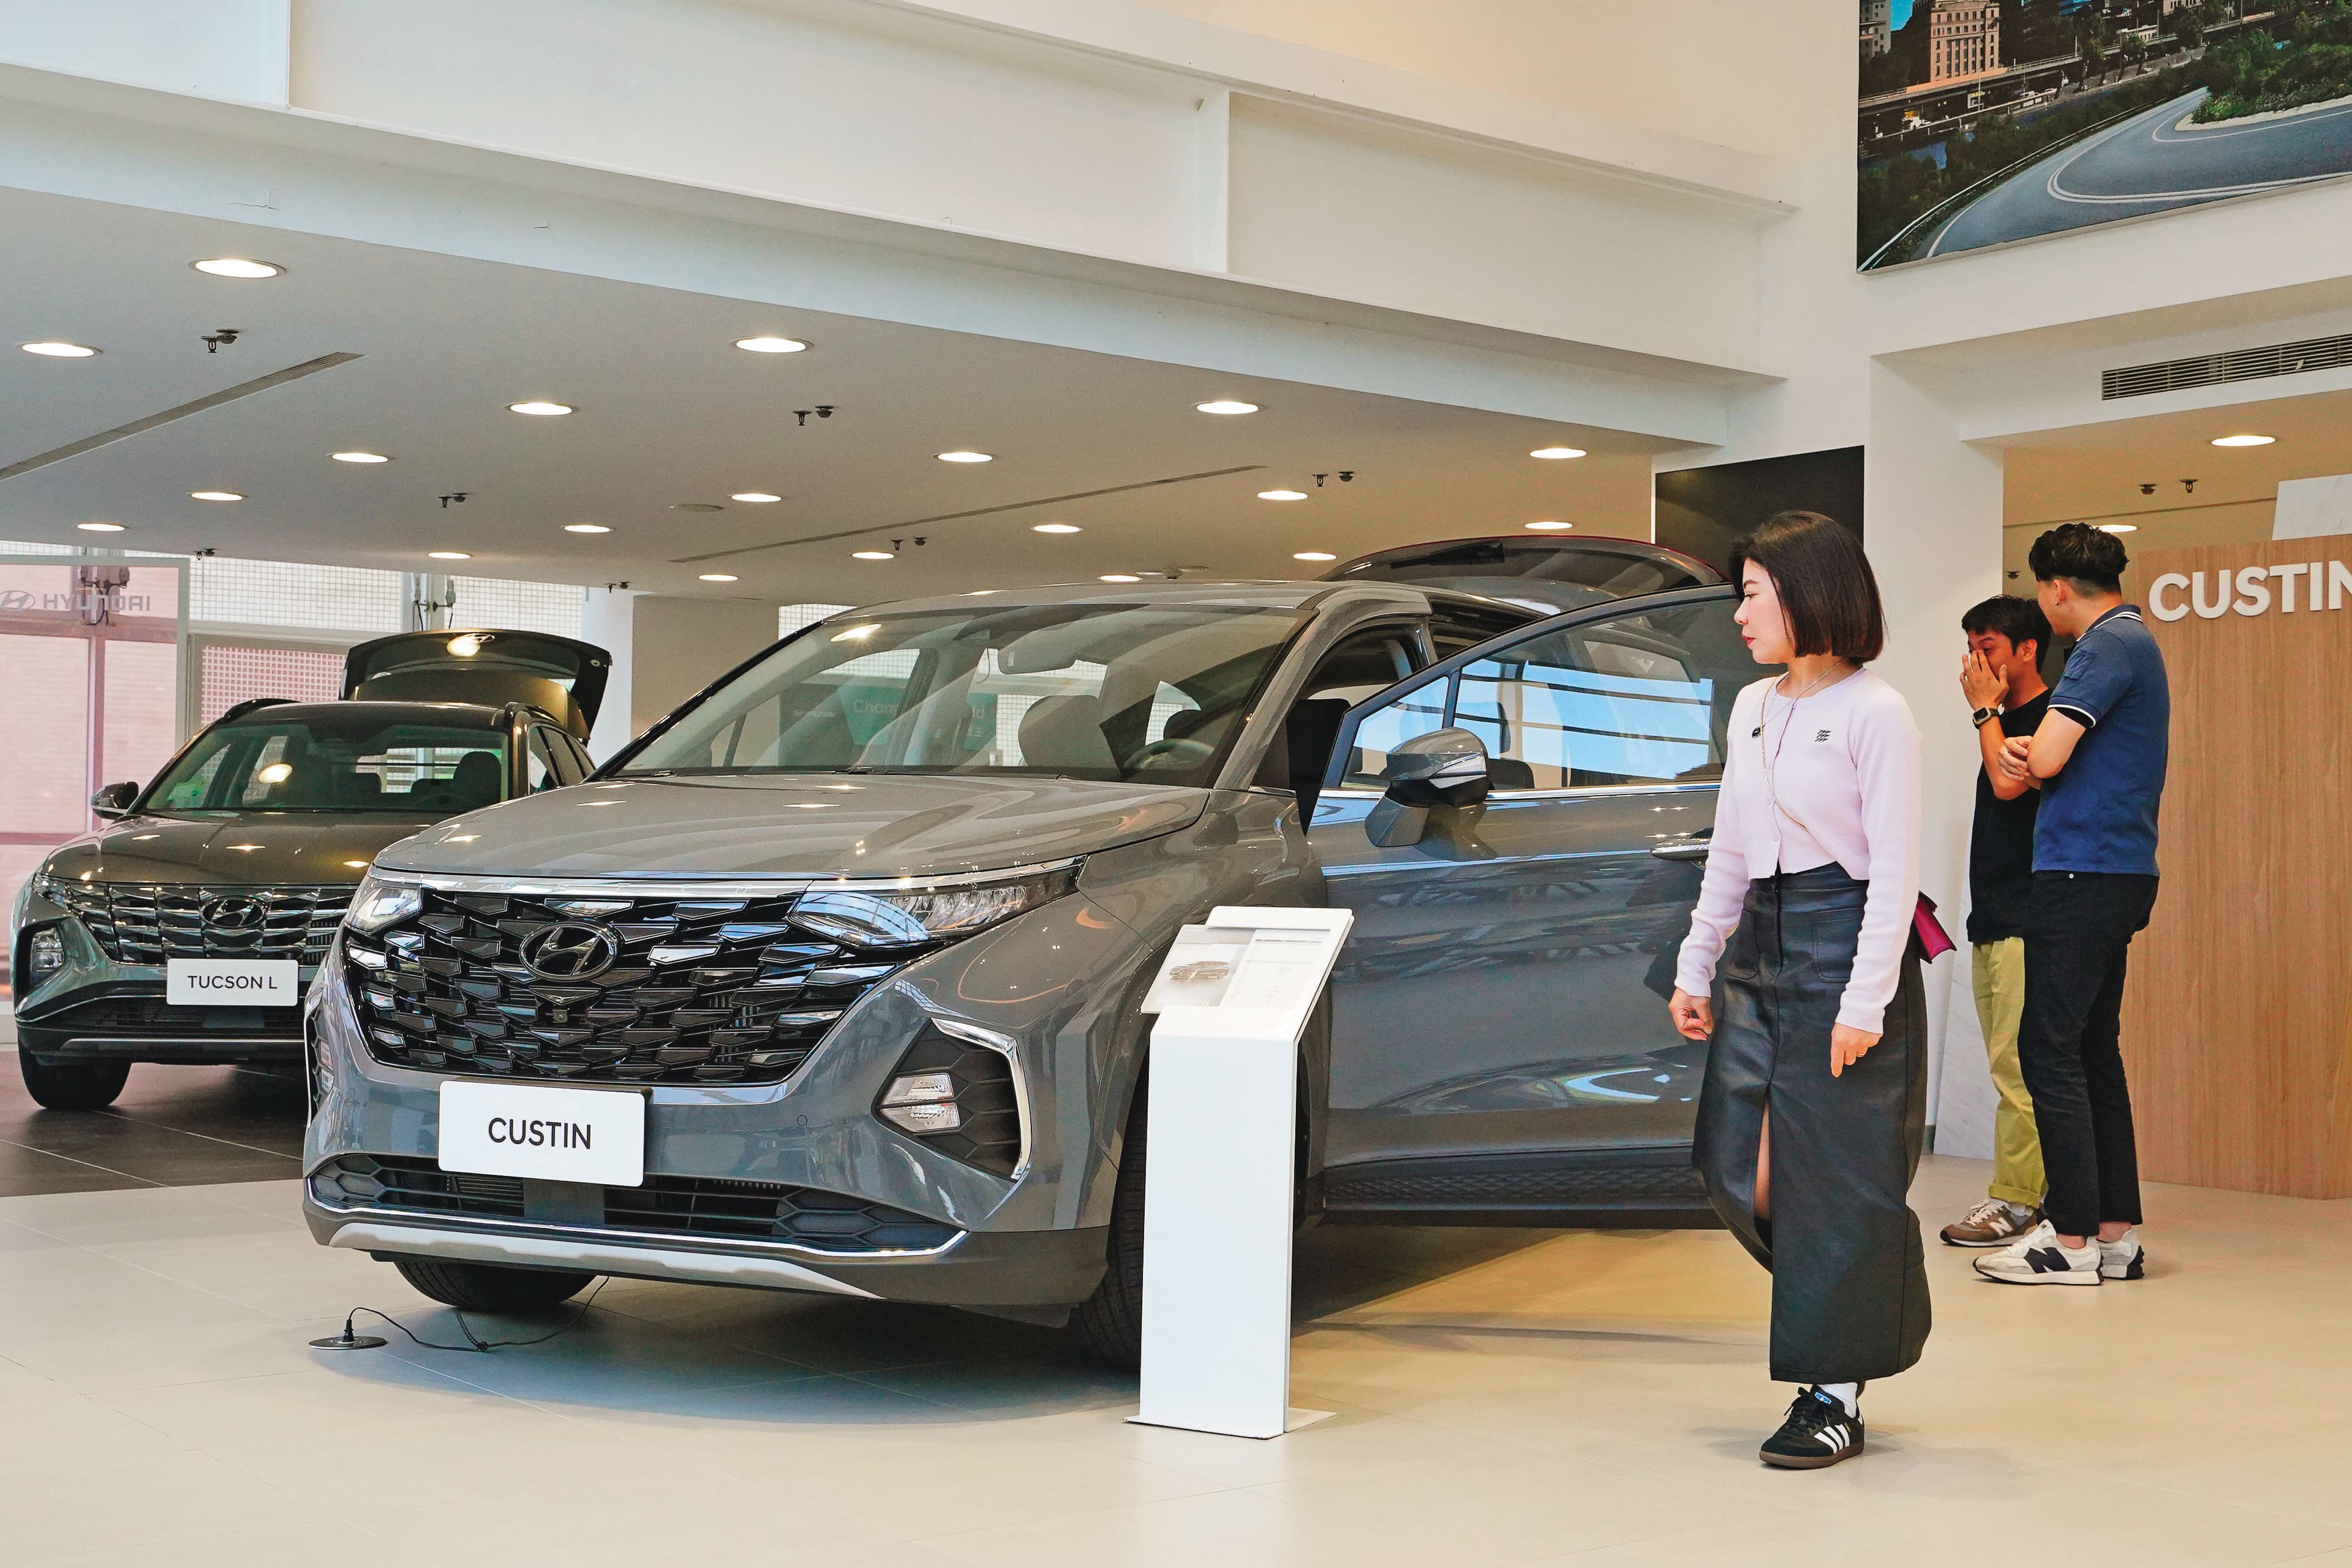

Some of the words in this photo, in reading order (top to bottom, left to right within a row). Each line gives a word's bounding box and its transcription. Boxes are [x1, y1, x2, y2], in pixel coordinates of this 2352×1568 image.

[43, 593, 151, 611] HYUNDAI
[2148, 560, 2352, 622] CUSTIN
[187, 975, 263, 989] TUCSON
[268, 976, 278, 989] L
[488, 1117, 592, 1150] CUSTIN
